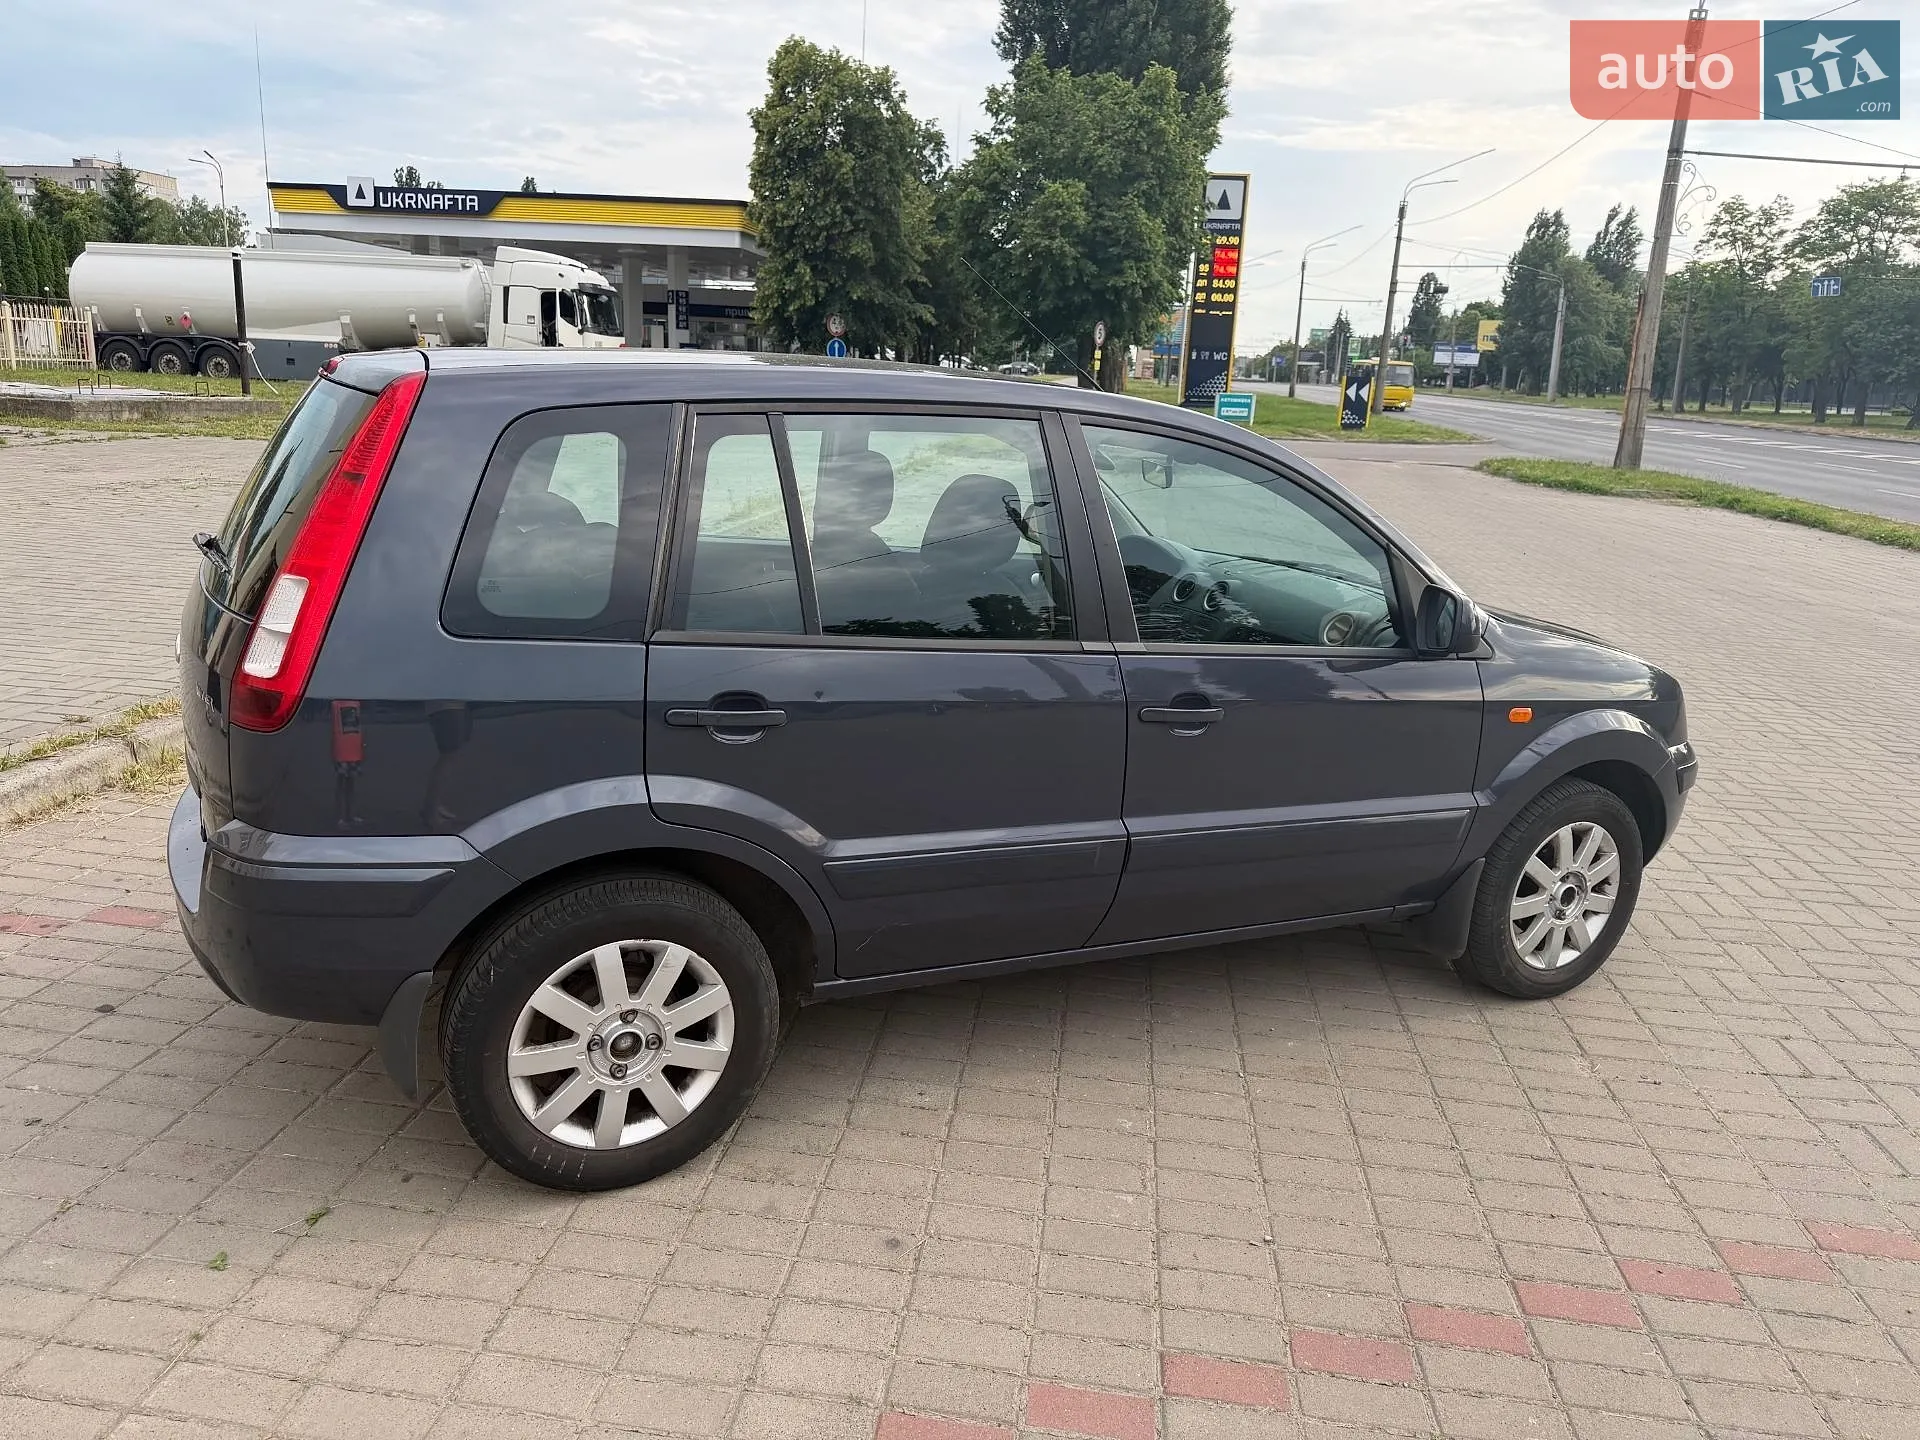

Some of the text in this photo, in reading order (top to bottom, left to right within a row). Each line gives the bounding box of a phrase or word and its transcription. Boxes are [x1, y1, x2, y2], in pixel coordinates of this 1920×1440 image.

[379, 191, 479, 211] UKRNAFTA
[1203, 222, 1240, 230] UKRNAFTA
[1212, 279, 1236, 288] 84.90
[1213, 351, 1228, 360] WC
